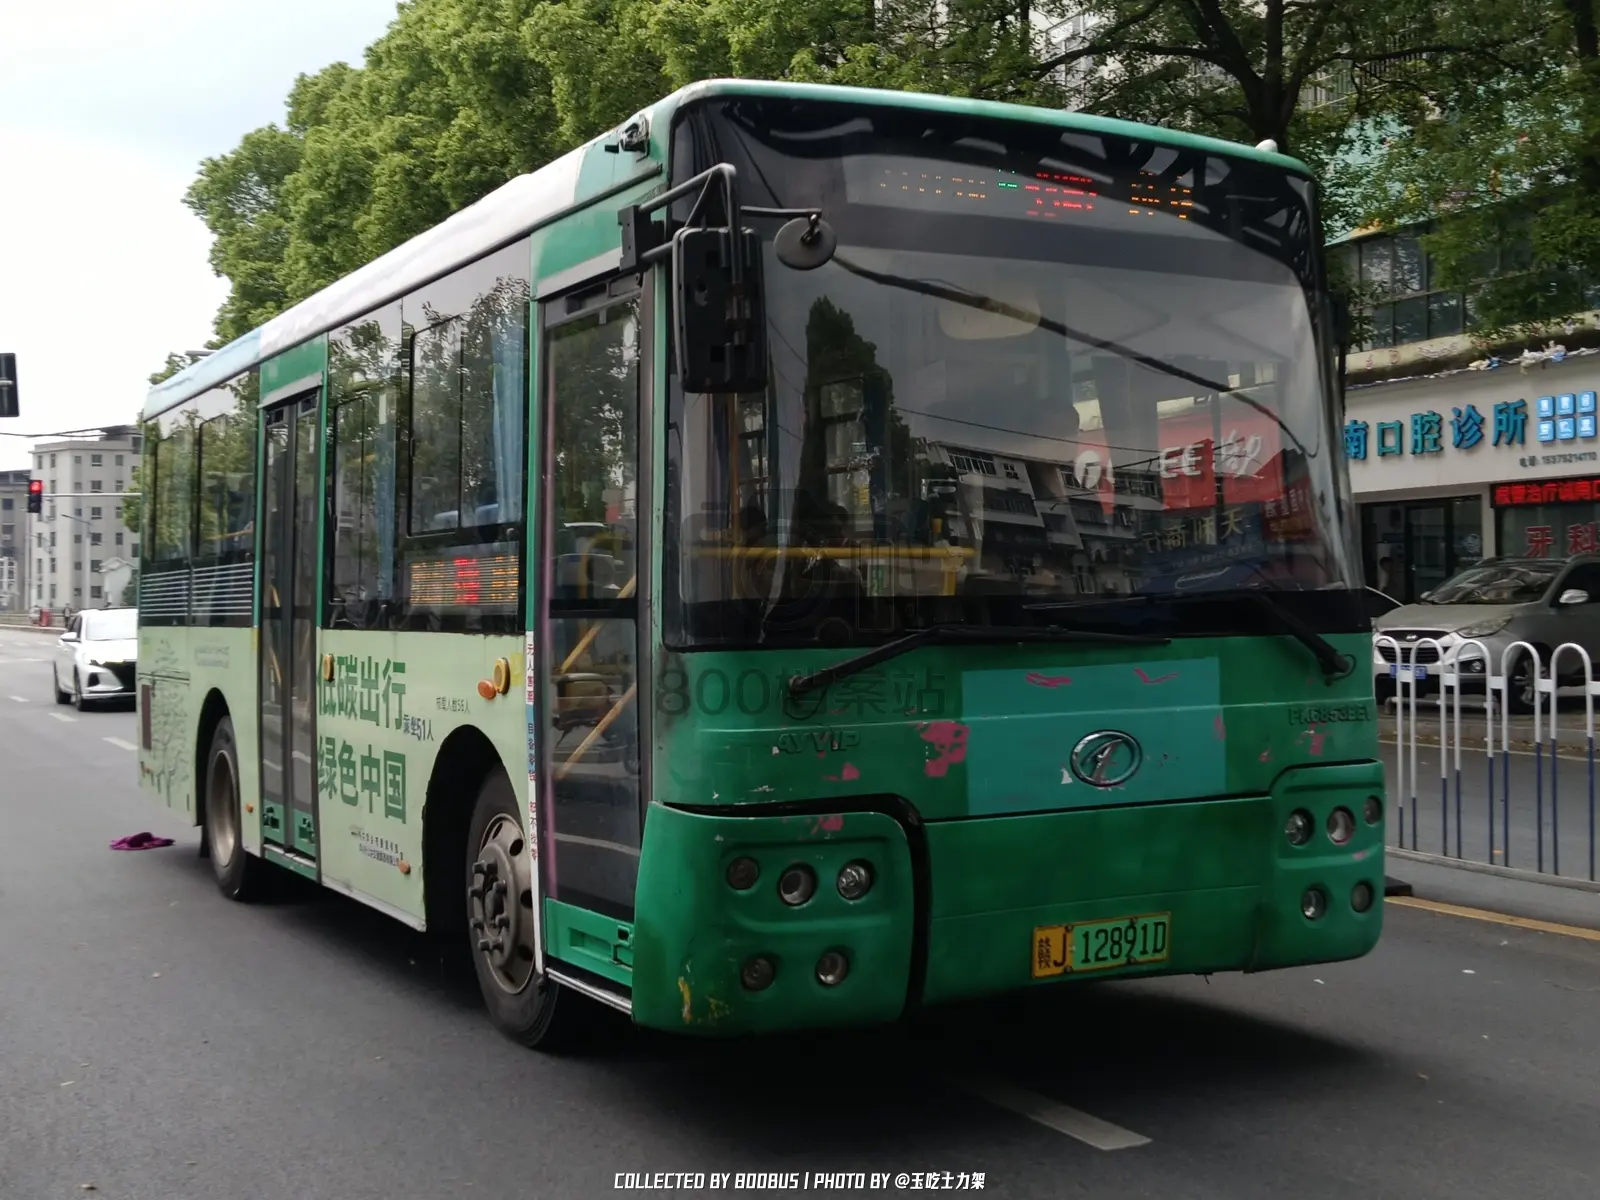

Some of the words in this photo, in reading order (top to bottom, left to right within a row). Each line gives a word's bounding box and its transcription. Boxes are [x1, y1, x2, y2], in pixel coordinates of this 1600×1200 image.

[1343, 398, 1528, 460] 南口腔诊所
[316, 653, 406, 731] 低碳出行
[318, 735, 407, 824] 绿色中国
